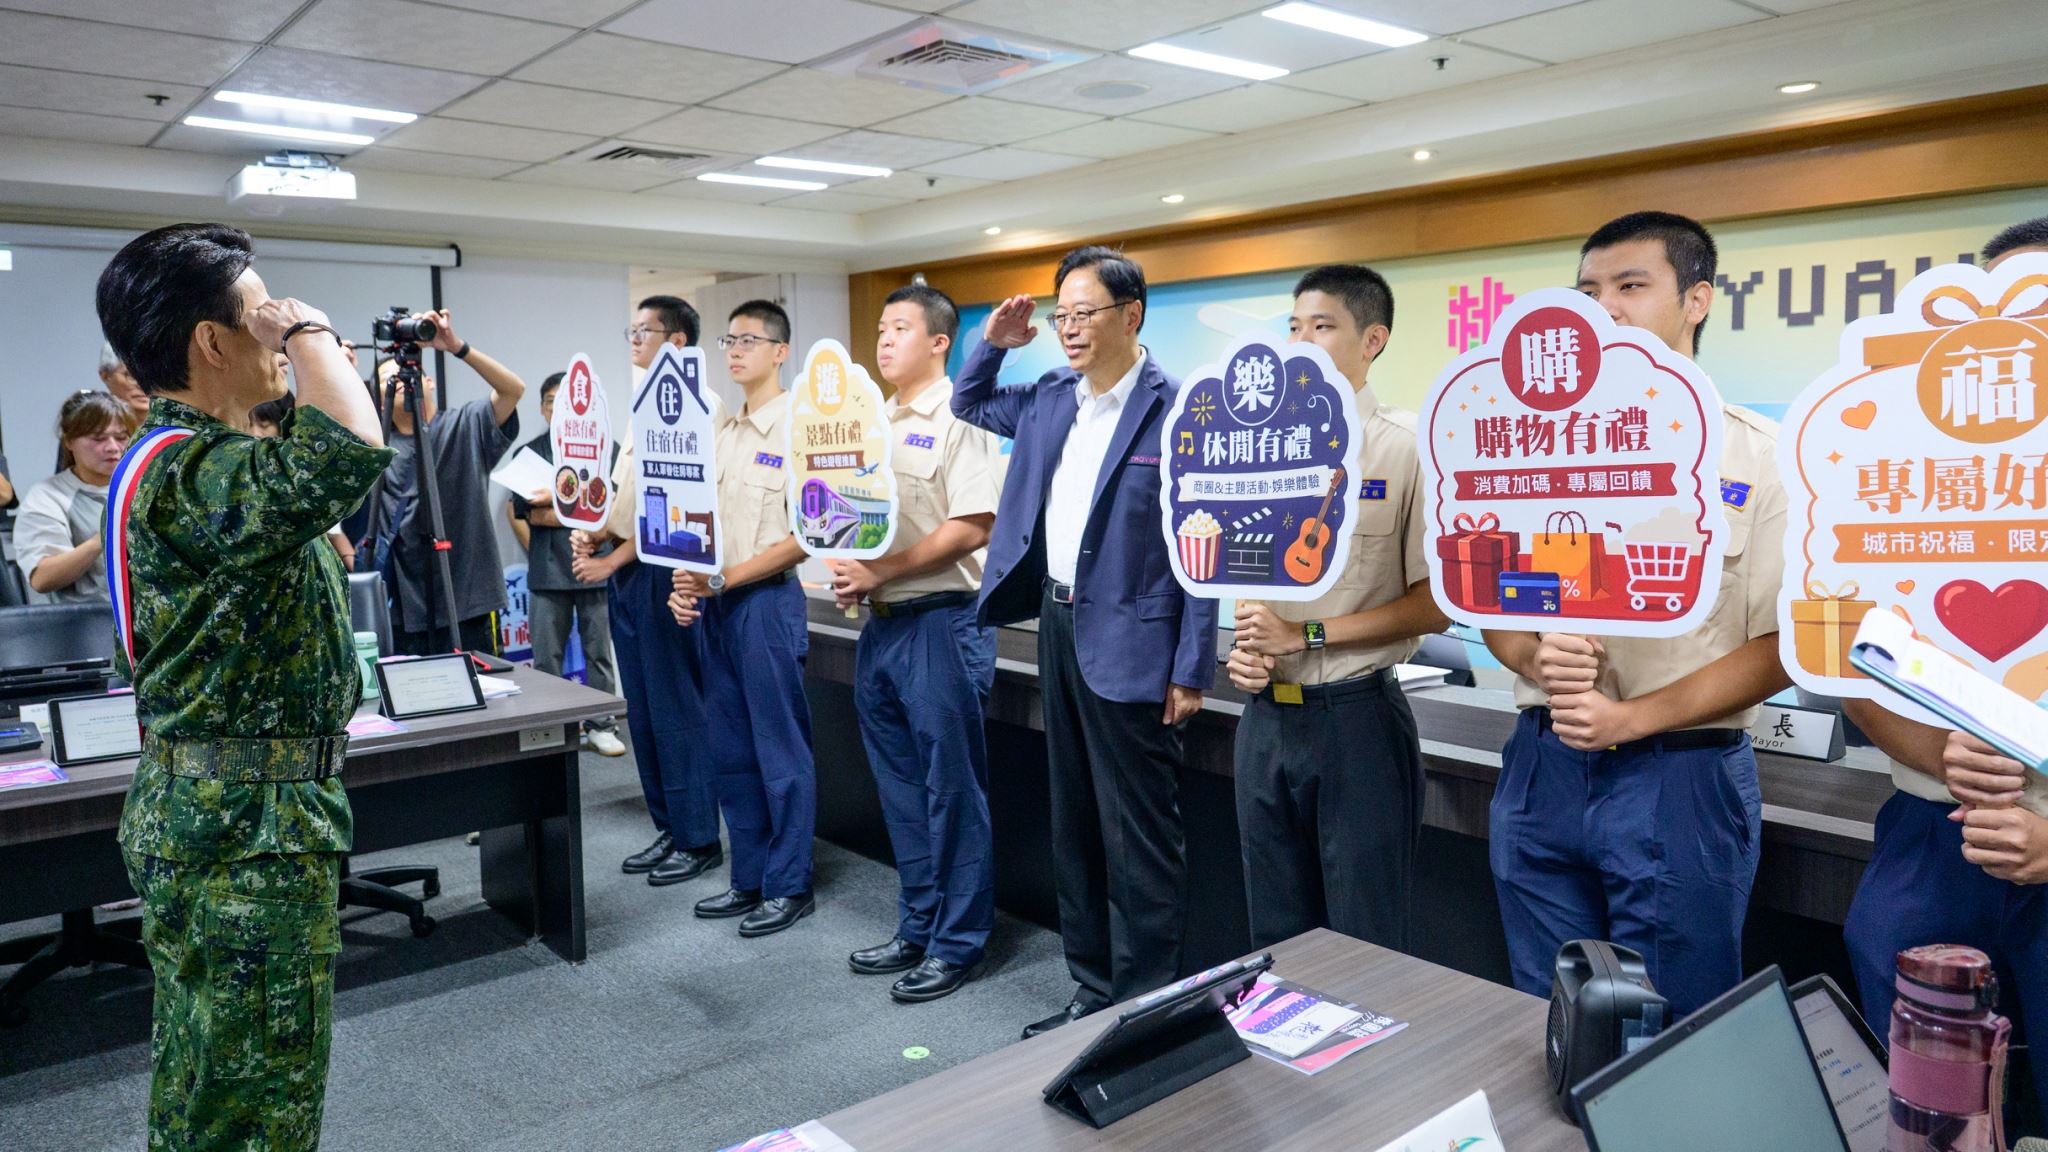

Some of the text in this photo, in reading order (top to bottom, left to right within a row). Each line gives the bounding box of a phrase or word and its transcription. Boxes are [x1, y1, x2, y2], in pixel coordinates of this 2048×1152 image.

[1232, 354, 1276, 412] 樂
[1520, 328, 1582, 396] 購
[1941, 338, 2037, 427] 福
[572, 368, 589, 407] 食
[661, 382, 680, 417] 住
[815, 362, 842, 406] 遊
[646, 429, 698, 455] 住宿有禮
[806, 419, 862, 447] 景點有禮
[1202, 424, 1312, 466] 休閒有禮
[1474, 406, 1652, 459] 購物有禮
[1773, 713, 1795, 738] 長
